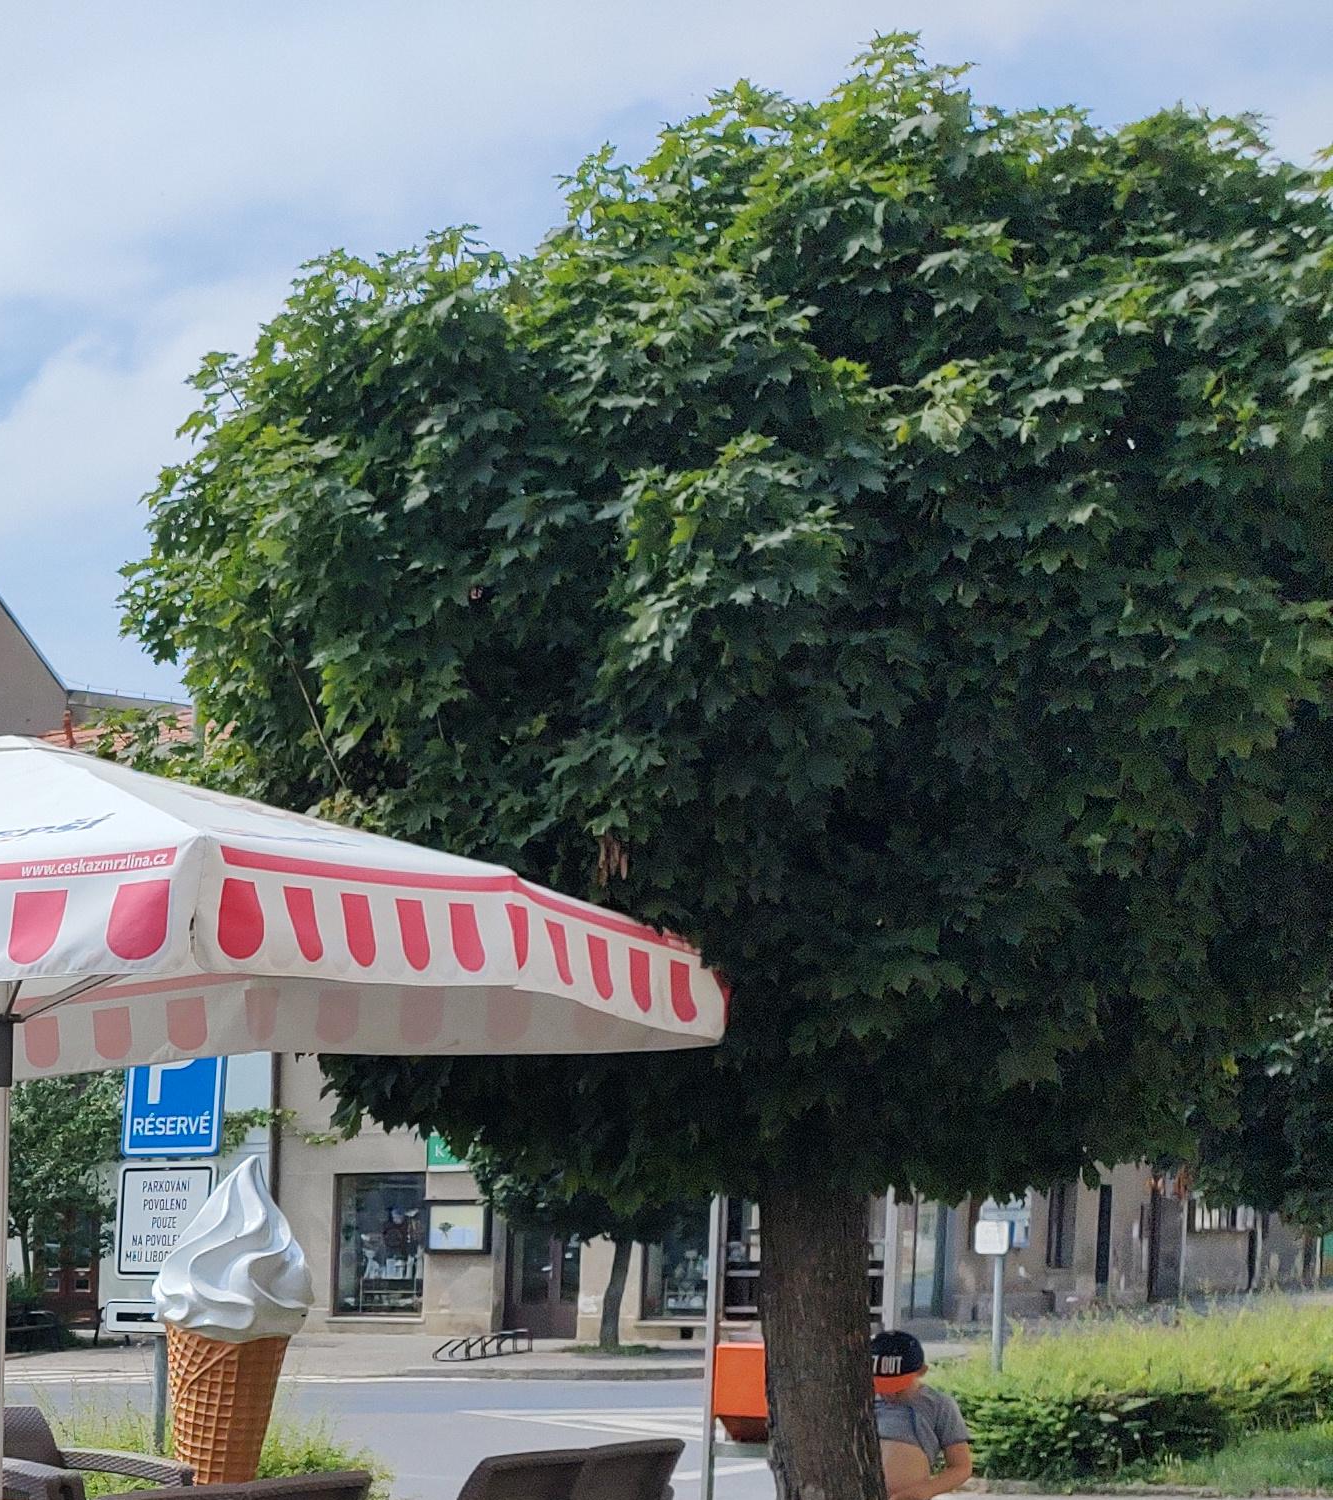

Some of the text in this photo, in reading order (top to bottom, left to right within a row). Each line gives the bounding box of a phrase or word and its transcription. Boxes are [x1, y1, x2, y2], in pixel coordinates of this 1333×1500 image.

[20, 851, 169, 878] www.ceskazmrzlina.cz
[132, 1111, 211, 1136] RÉSERVÉ
[142, 1177, 192, 1193] PARKOVÁNÍ
[143, 1199, 188, 1211] POVOLENO
[151, 1217, 177, 1229] POUZE
[132, 1234, 181, 1247] NA POVOLE
[144, 1250, 172, 1263] LIBOC
[881, 1355, 903, 1375] OUT
